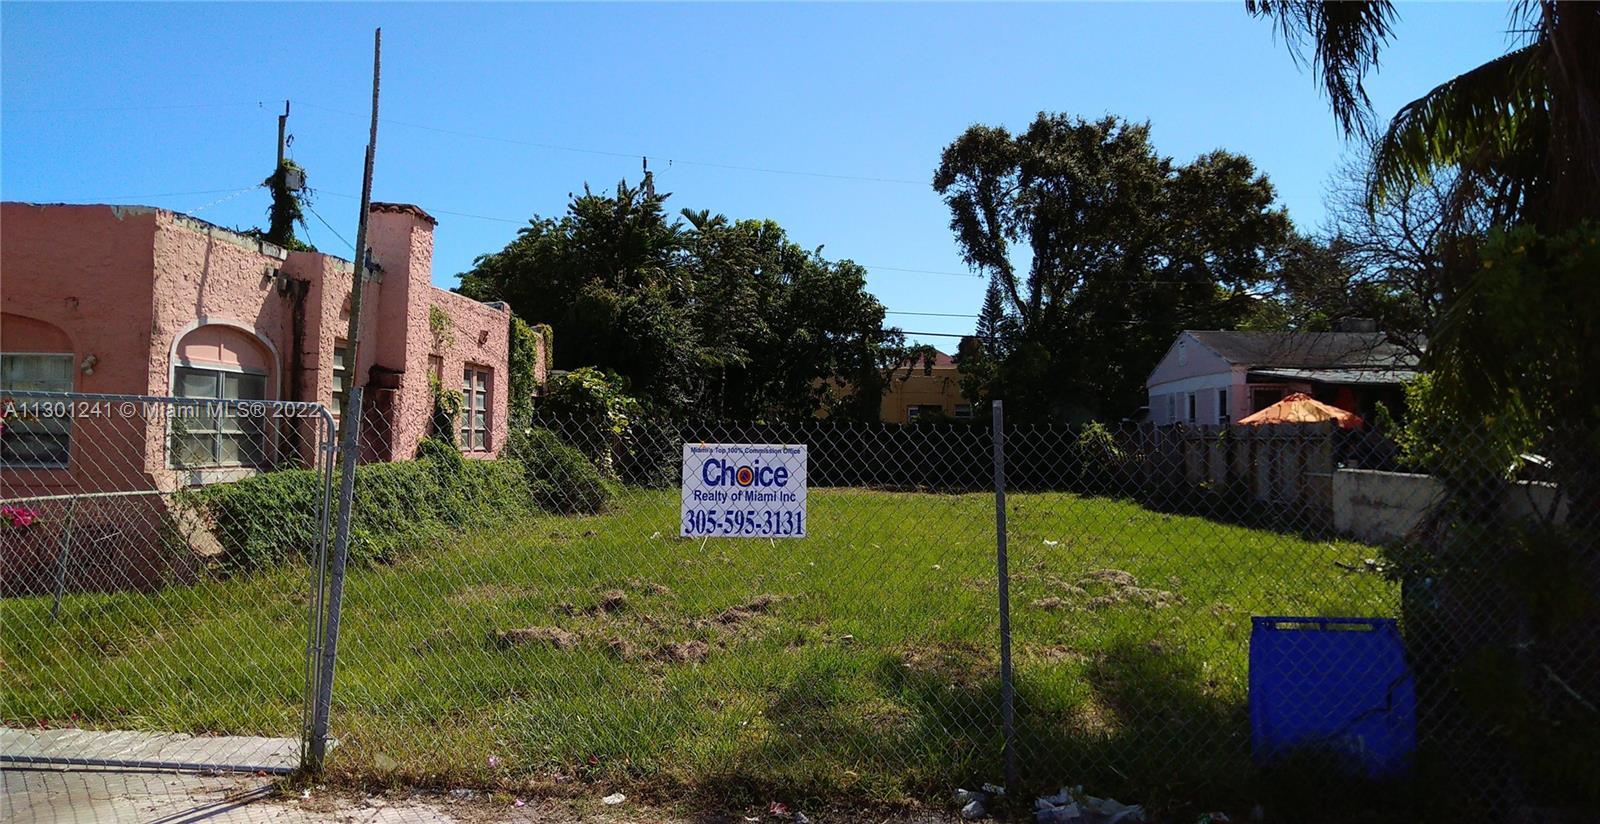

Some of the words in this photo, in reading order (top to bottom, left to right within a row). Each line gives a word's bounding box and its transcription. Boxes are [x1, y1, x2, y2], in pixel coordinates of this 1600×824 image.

[715, 447, 726, 455] Top
[744, 447, 782, 455] Commission
[783, 447, 801, 455] Office
[702, 458, 789, 487] Choice
[693, 490, 728, 504] Realty
[731, 490, 742, 502] of
[745, 490, 777, 502] Miami
[780, 490, 796, 502] Inc
[684, 509, 803, 535] 305-595-3131
